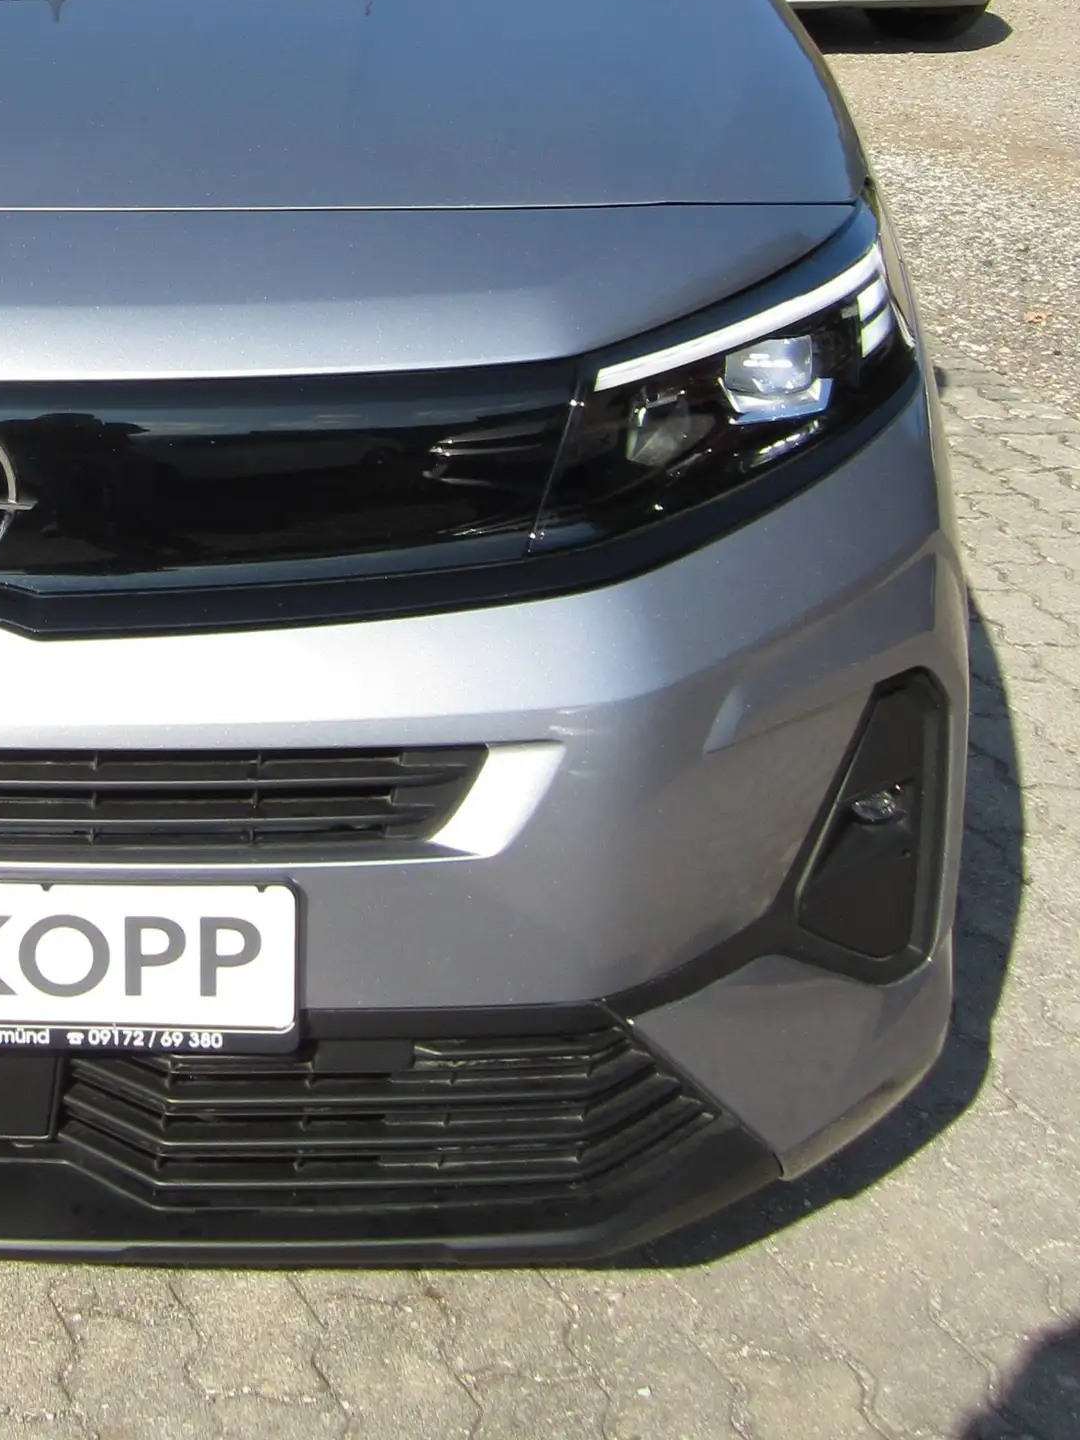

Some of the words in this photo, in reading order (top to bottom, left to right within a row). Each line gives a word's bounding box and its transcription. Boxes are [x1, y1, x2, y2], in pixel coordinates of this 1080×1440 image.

[88, 1027, 145, 1047] 09172
[160, 1030, 183, 1048] 69
[188, 1031, 223, 1049] 380
